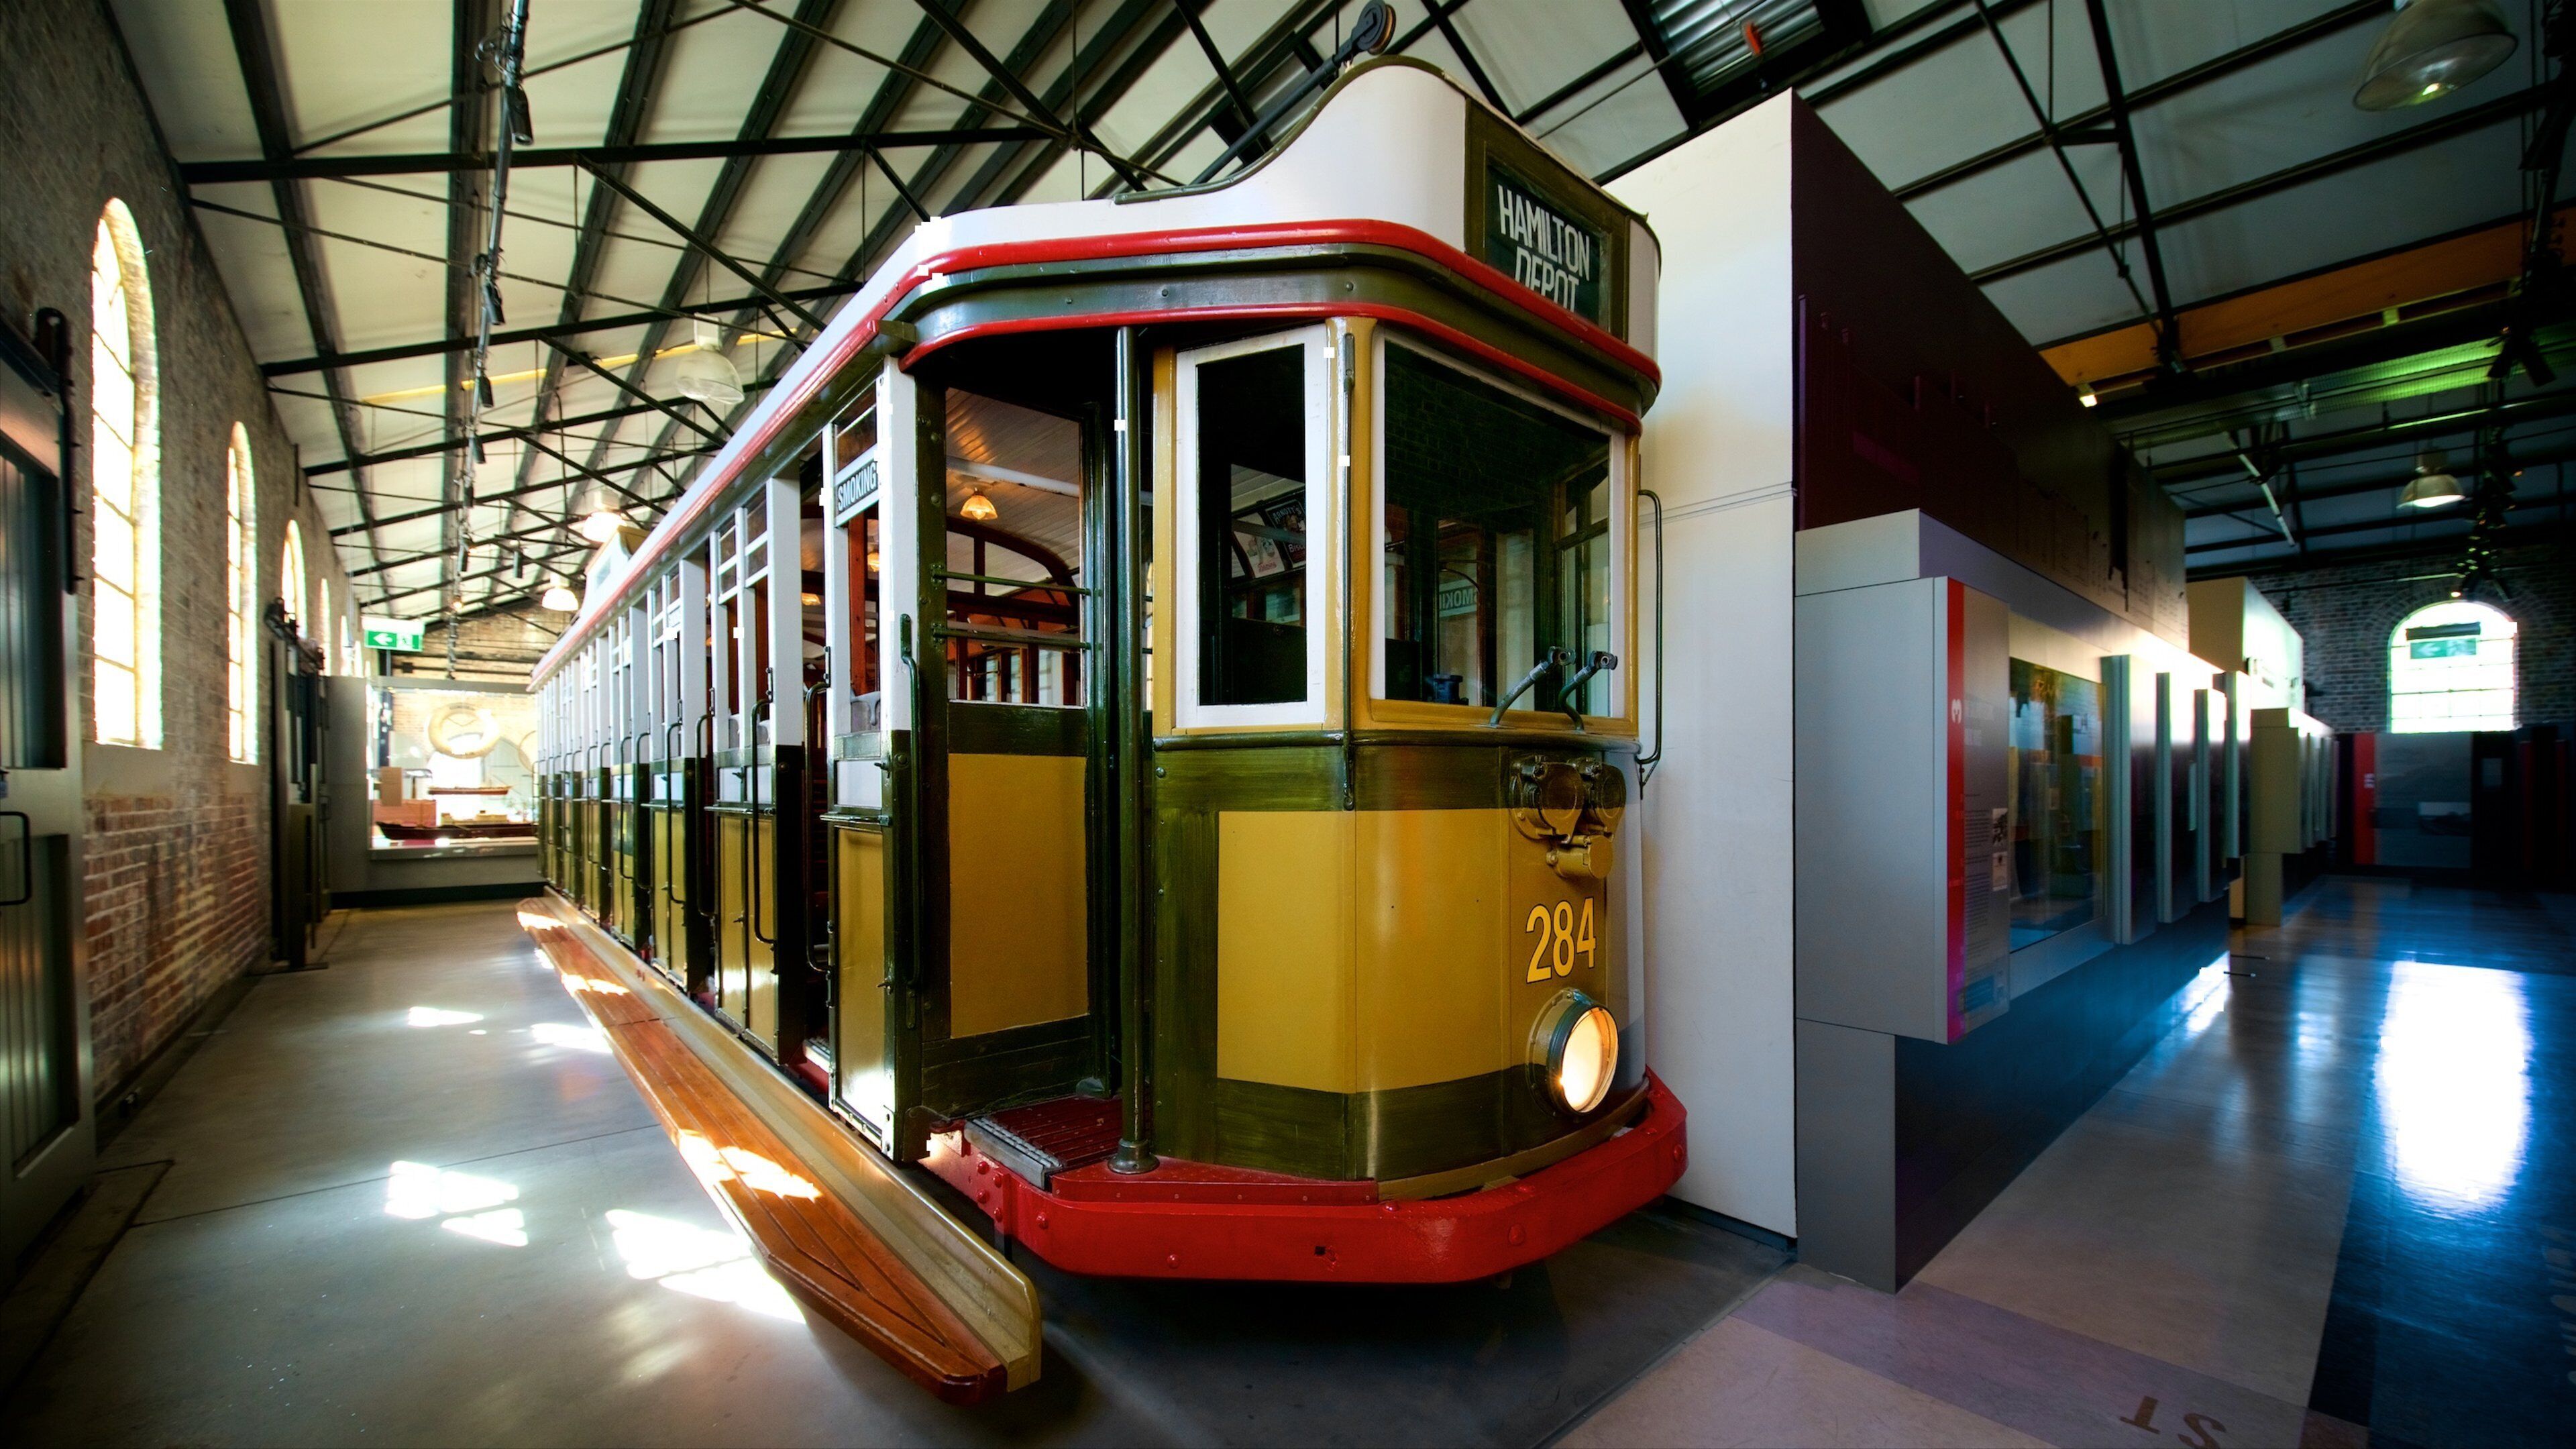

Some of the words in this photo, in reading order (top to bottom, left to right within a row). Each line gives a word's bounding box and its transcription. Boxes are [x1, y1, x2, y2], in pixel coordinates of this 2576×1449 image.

[1498, 184, 1589, 281] HAMILTON
[1515, 246, 1579, 312] DEPOT
[838, 462, 877, 511] SMOKING
[1525, 897, 1597, 983] 284
[2119, 1396, 2226, 1449] ST
